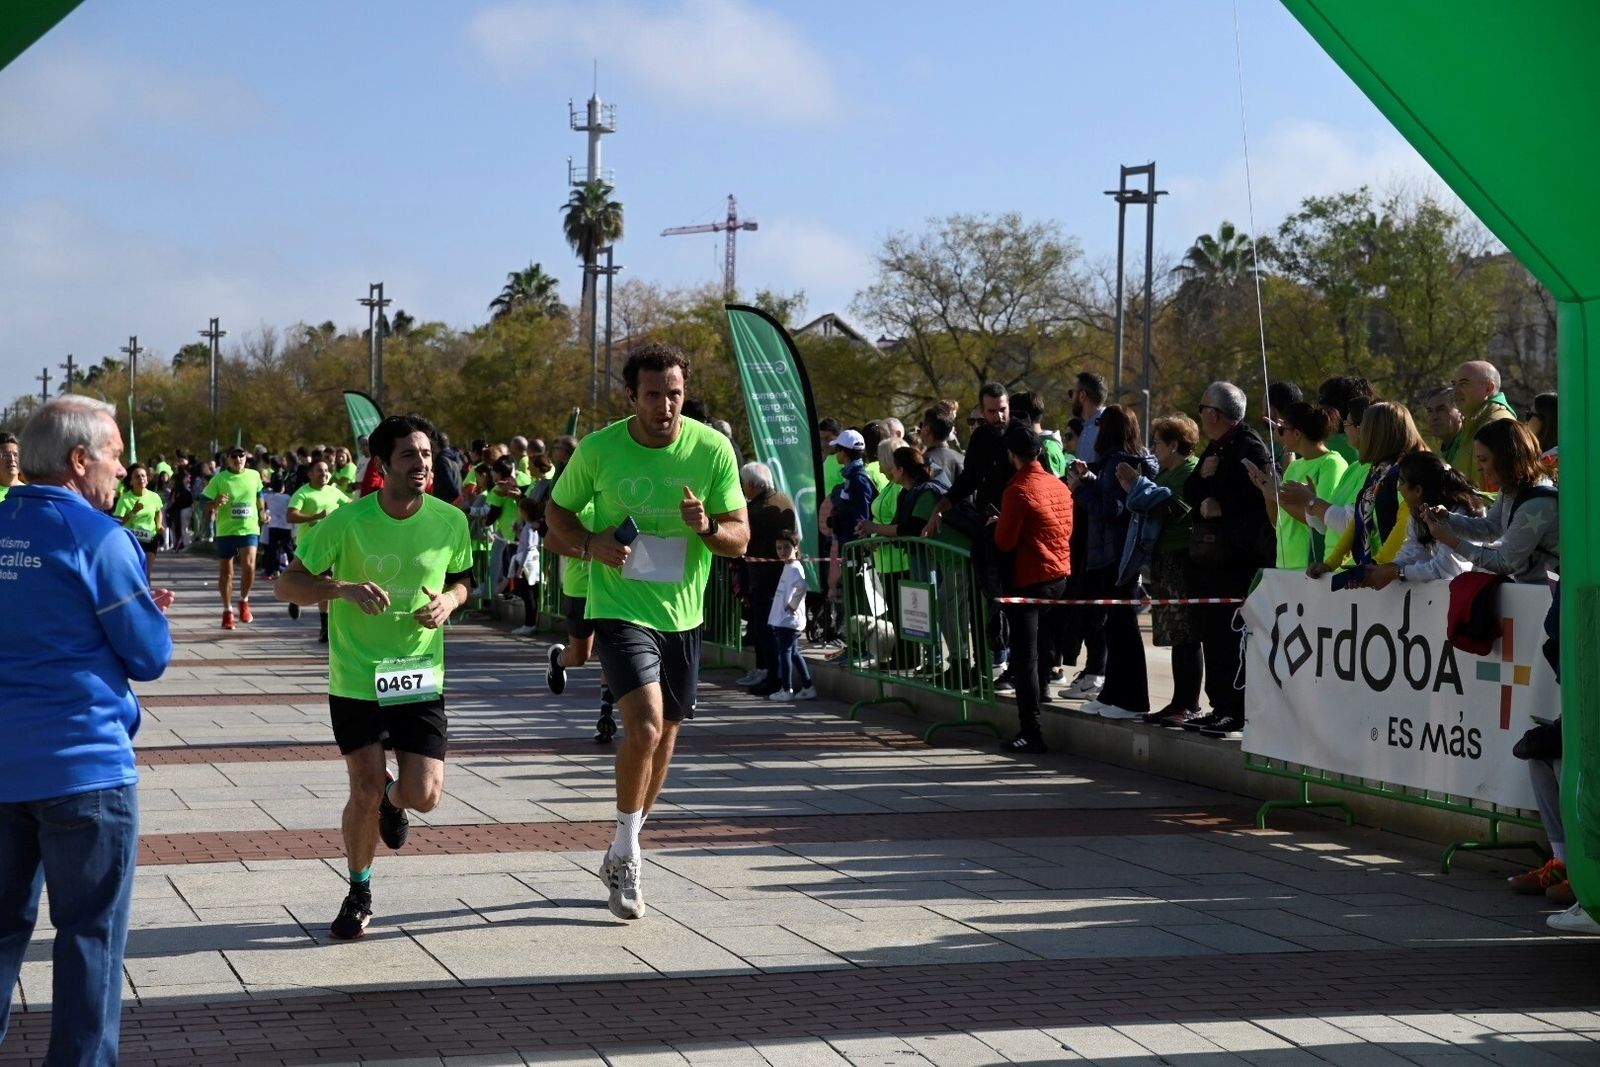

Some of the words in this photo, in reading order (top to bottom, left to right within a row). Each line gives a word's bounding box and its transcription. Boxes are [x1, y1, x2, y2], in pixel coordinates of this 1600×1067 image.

[0, 551, 42, 568] calles
[376, 673, 424, 693] 0467
[1387, 716, 1414, 749] ES
